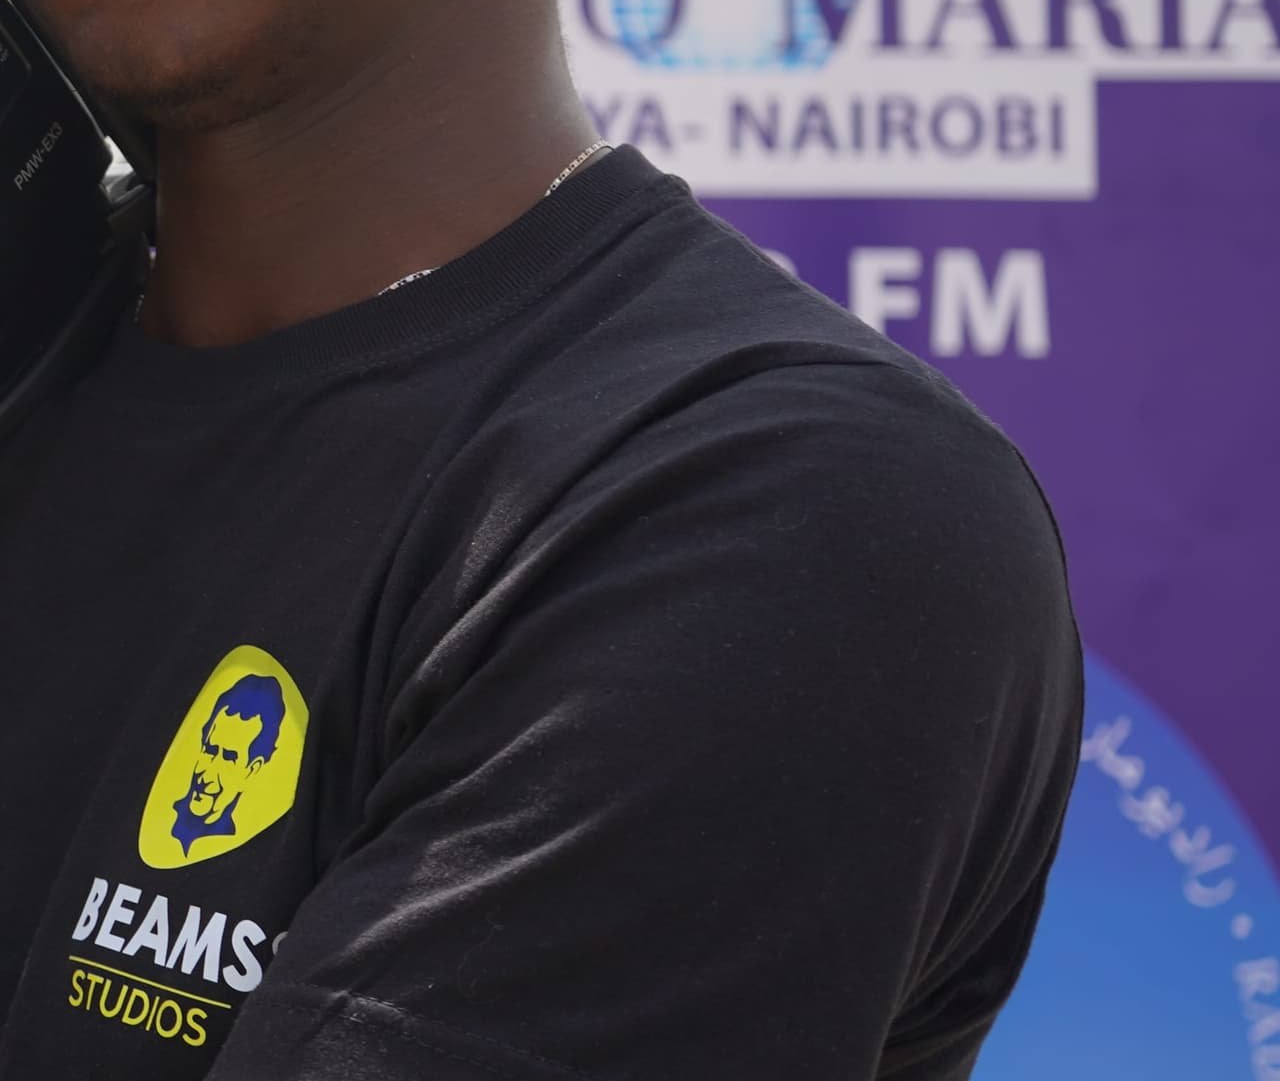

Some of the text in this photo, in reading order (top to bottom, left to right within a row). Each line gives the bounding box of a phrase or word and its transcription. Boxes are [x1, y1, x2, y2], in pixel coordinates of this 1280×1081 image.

[14, 121, 64, 191] PMW-EX3
[730, 95, 1066, 158] NAIROBI
[848, 248, 1050, 358] FM
[71, 877, 267, 993] BEAMS
[68, 969, 208, 1047] STUDIOS
